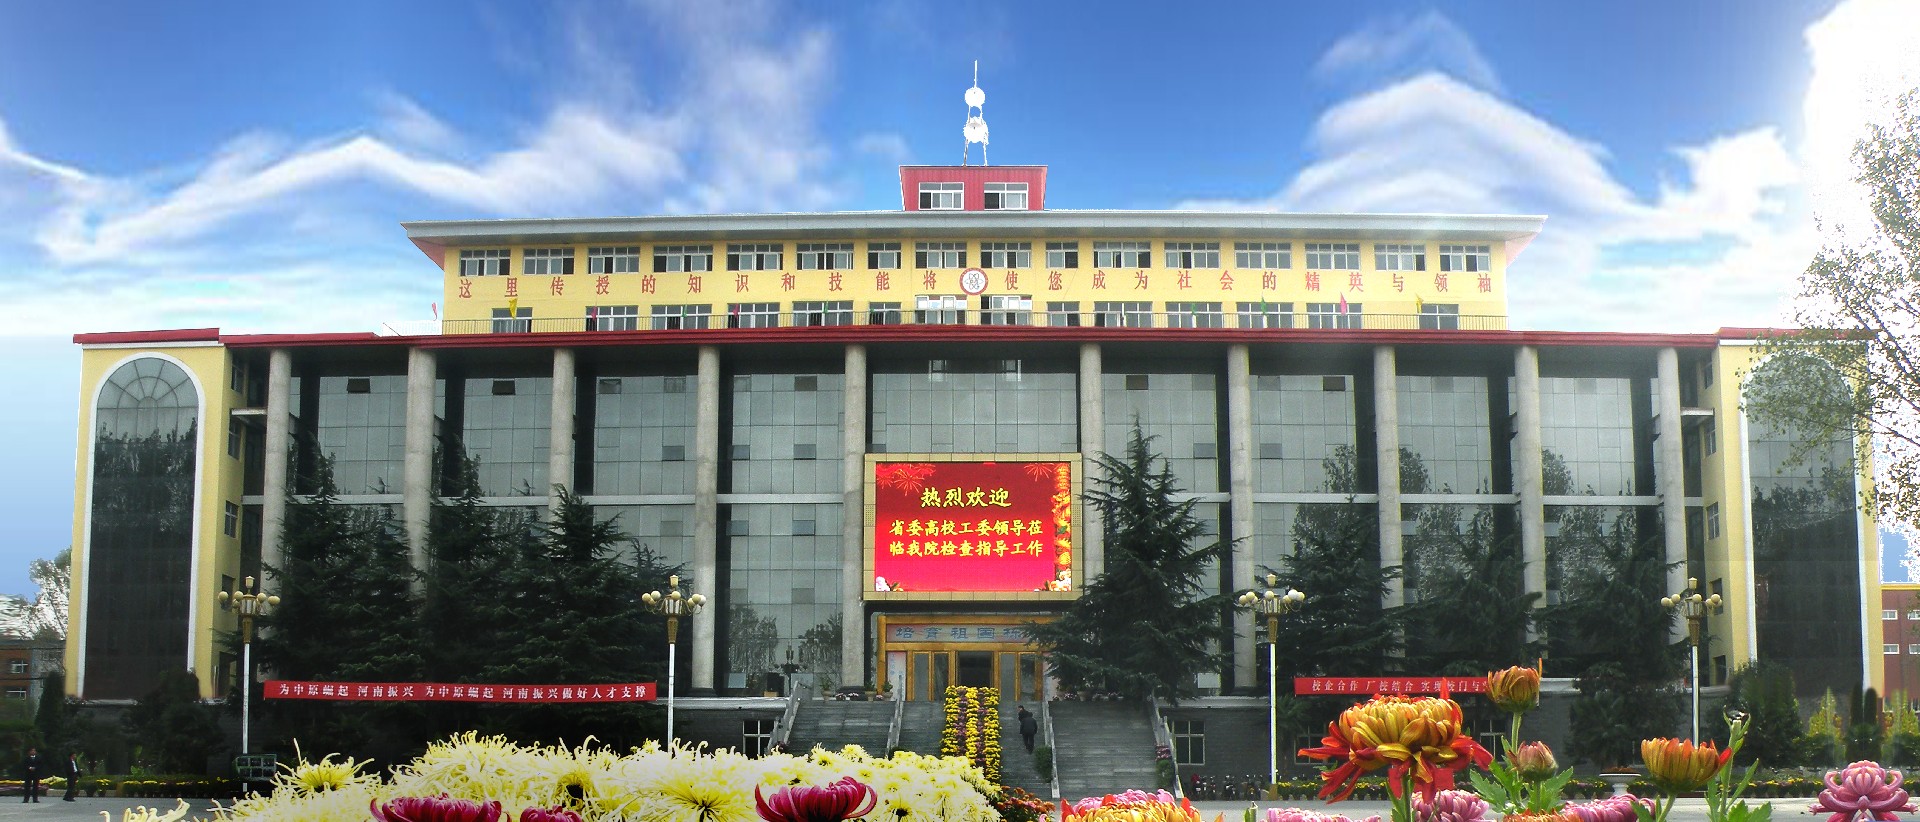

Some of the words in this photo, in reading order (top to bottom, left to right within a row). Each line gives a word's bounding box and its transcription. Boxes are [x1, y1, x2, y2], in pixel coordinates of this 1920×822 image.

[459, 270, 937, 298] 这里传授的知识和技能将
[1004, 270, 1492, 293] 使您成为社会的精英与领袖
[921, 487, 1011, 508] 热烈欢迎
[889, 519, 1043, 537] 省委高校工委领导莅
[889, 540, 1043, 557] 临我院检查指导工作
[279, 684, 349, 698] 为中原崛起
[358, 685, 414, 698] 河南振兴
[425, 686, 494, 699] 为中原崛起
[503, 685, 646, 700] 河南振兴做好人才支撑
[1312, 679, 1359, 692] 校企合作
